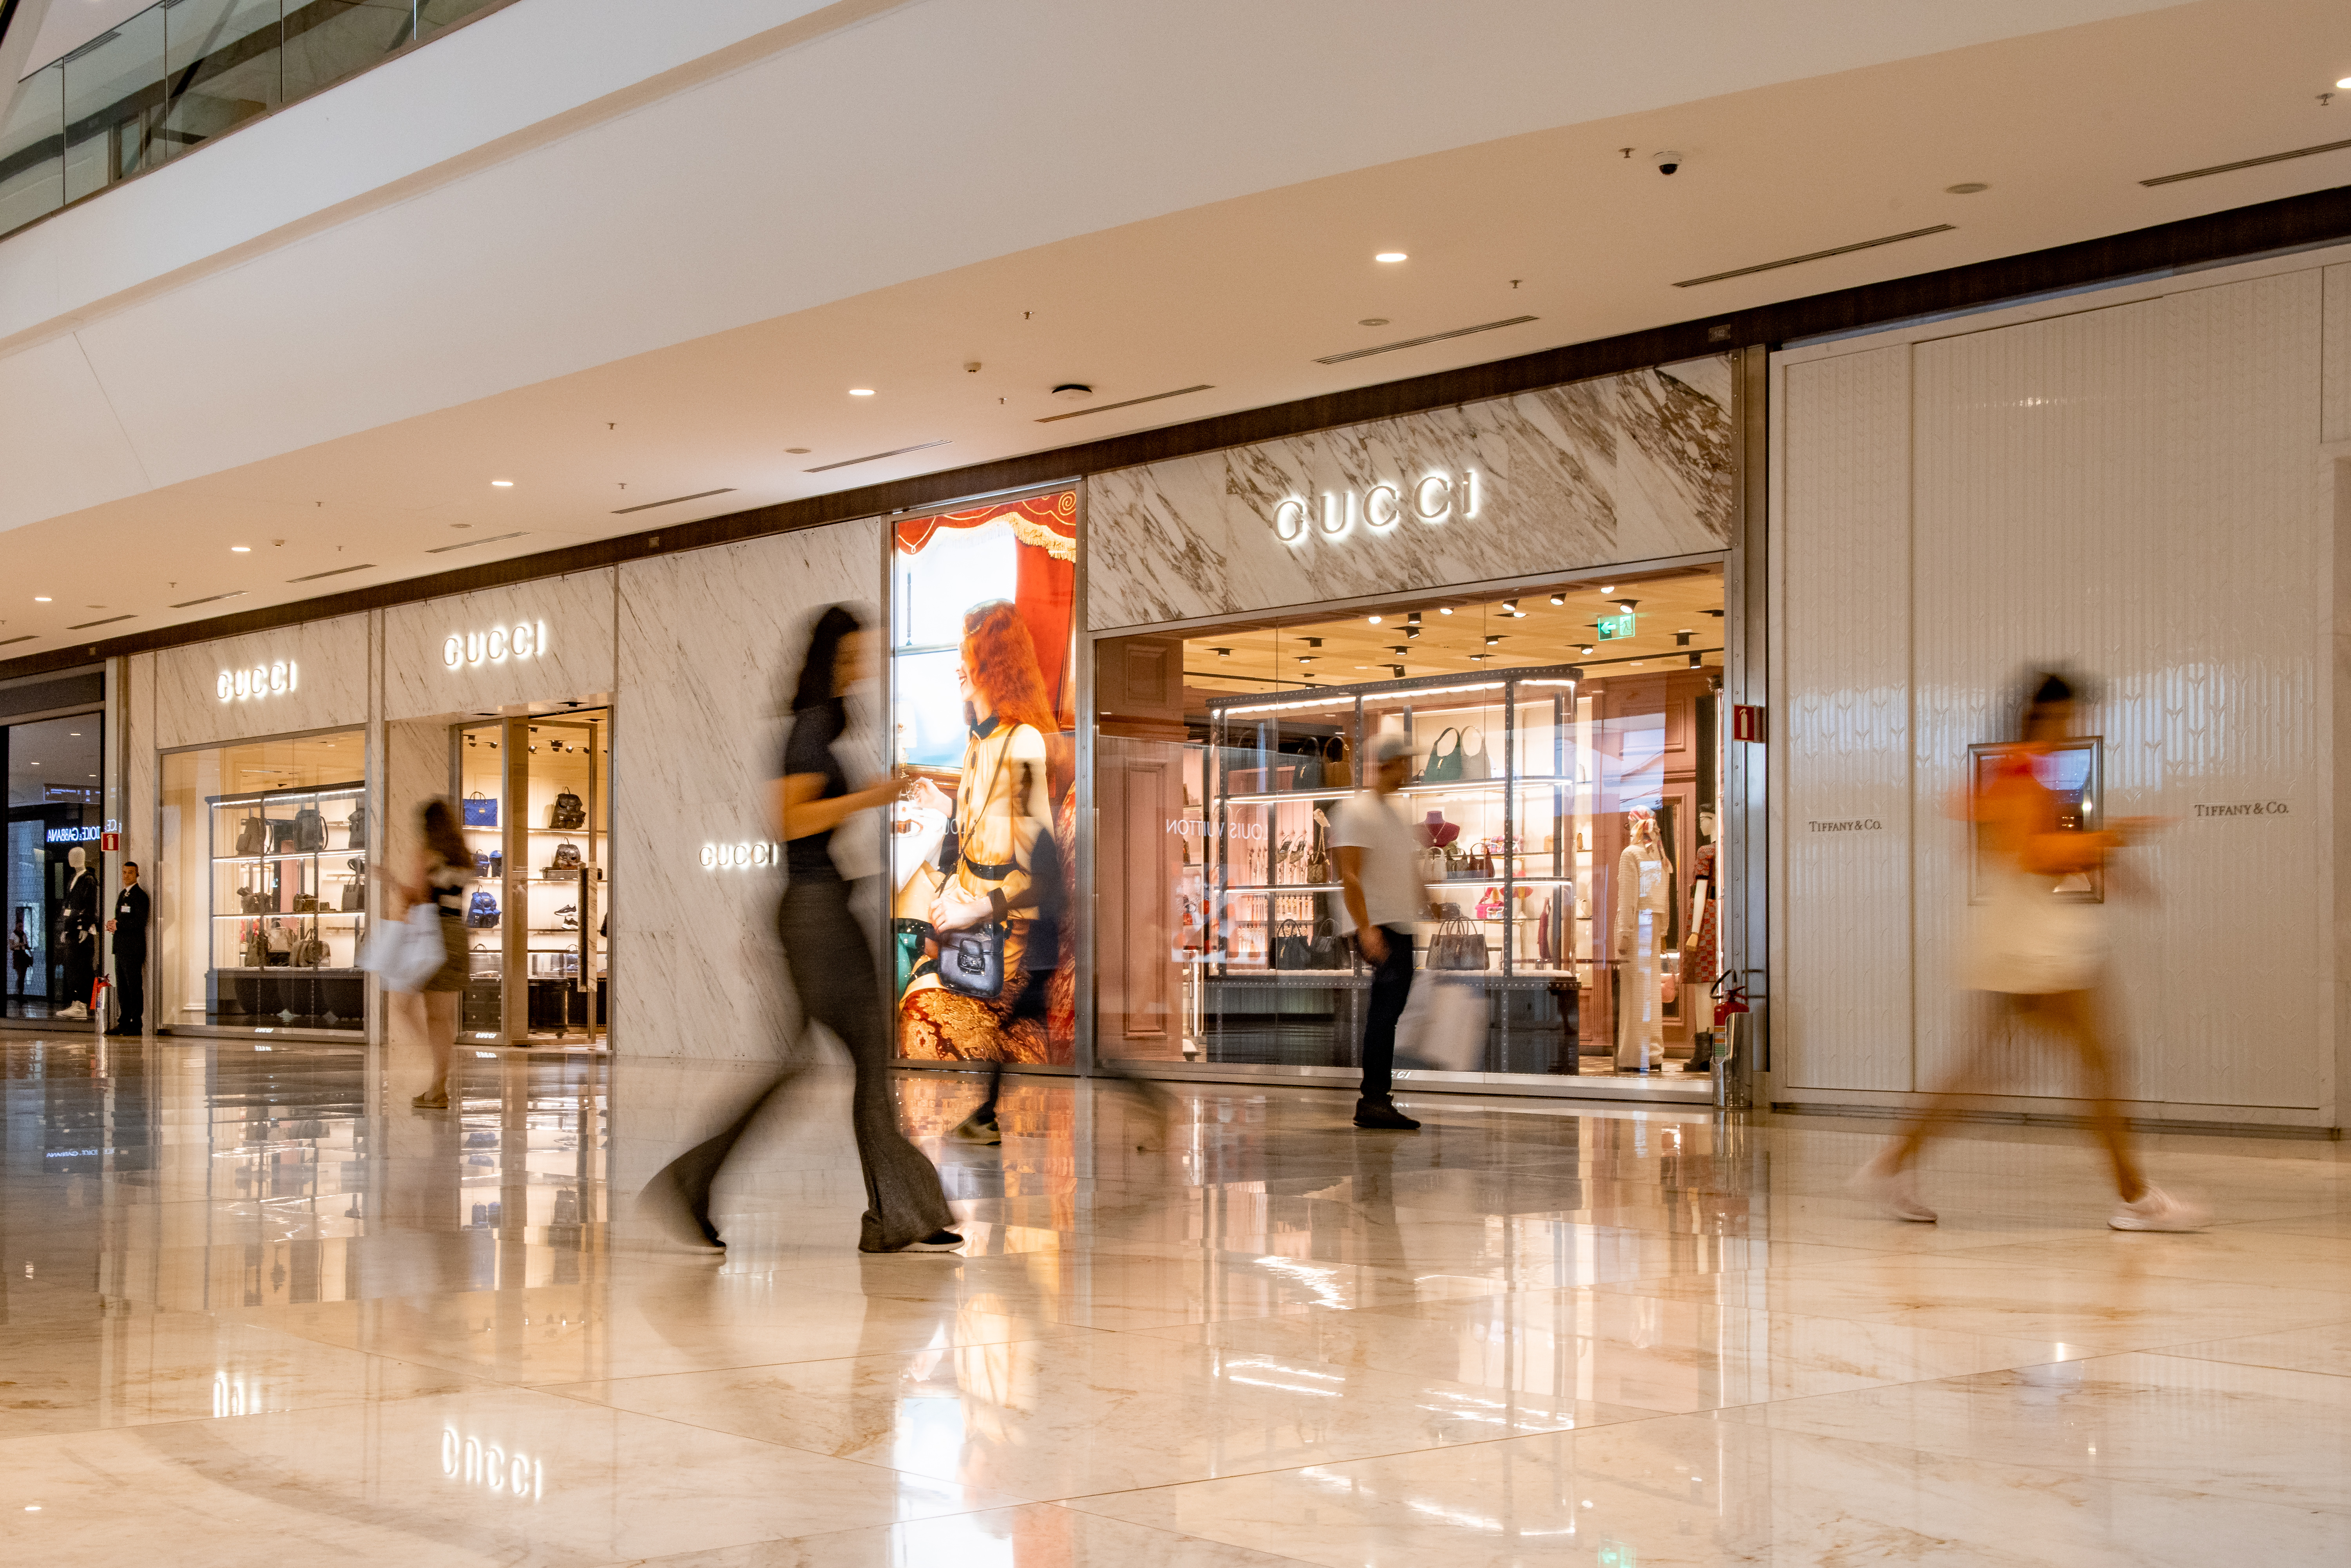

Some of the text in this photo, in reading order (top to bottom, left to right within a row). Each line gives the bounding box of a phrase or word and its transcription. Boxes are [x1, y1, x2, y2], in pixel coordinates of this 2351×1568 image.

[1273, 471, 1476, 541] GUCCI
[442, 622, 545, 667] GUCCI
[216, 662, 297, 701] GUCCI
[1809, 821, 1854, 832] TIFFANY
[1855, 820, 1862, 830] &
[2194, 804, 2252, 817] TIFFANY
[2253, 803, 2264, 815] &
[699, 843, 778, 868] GUCCI
